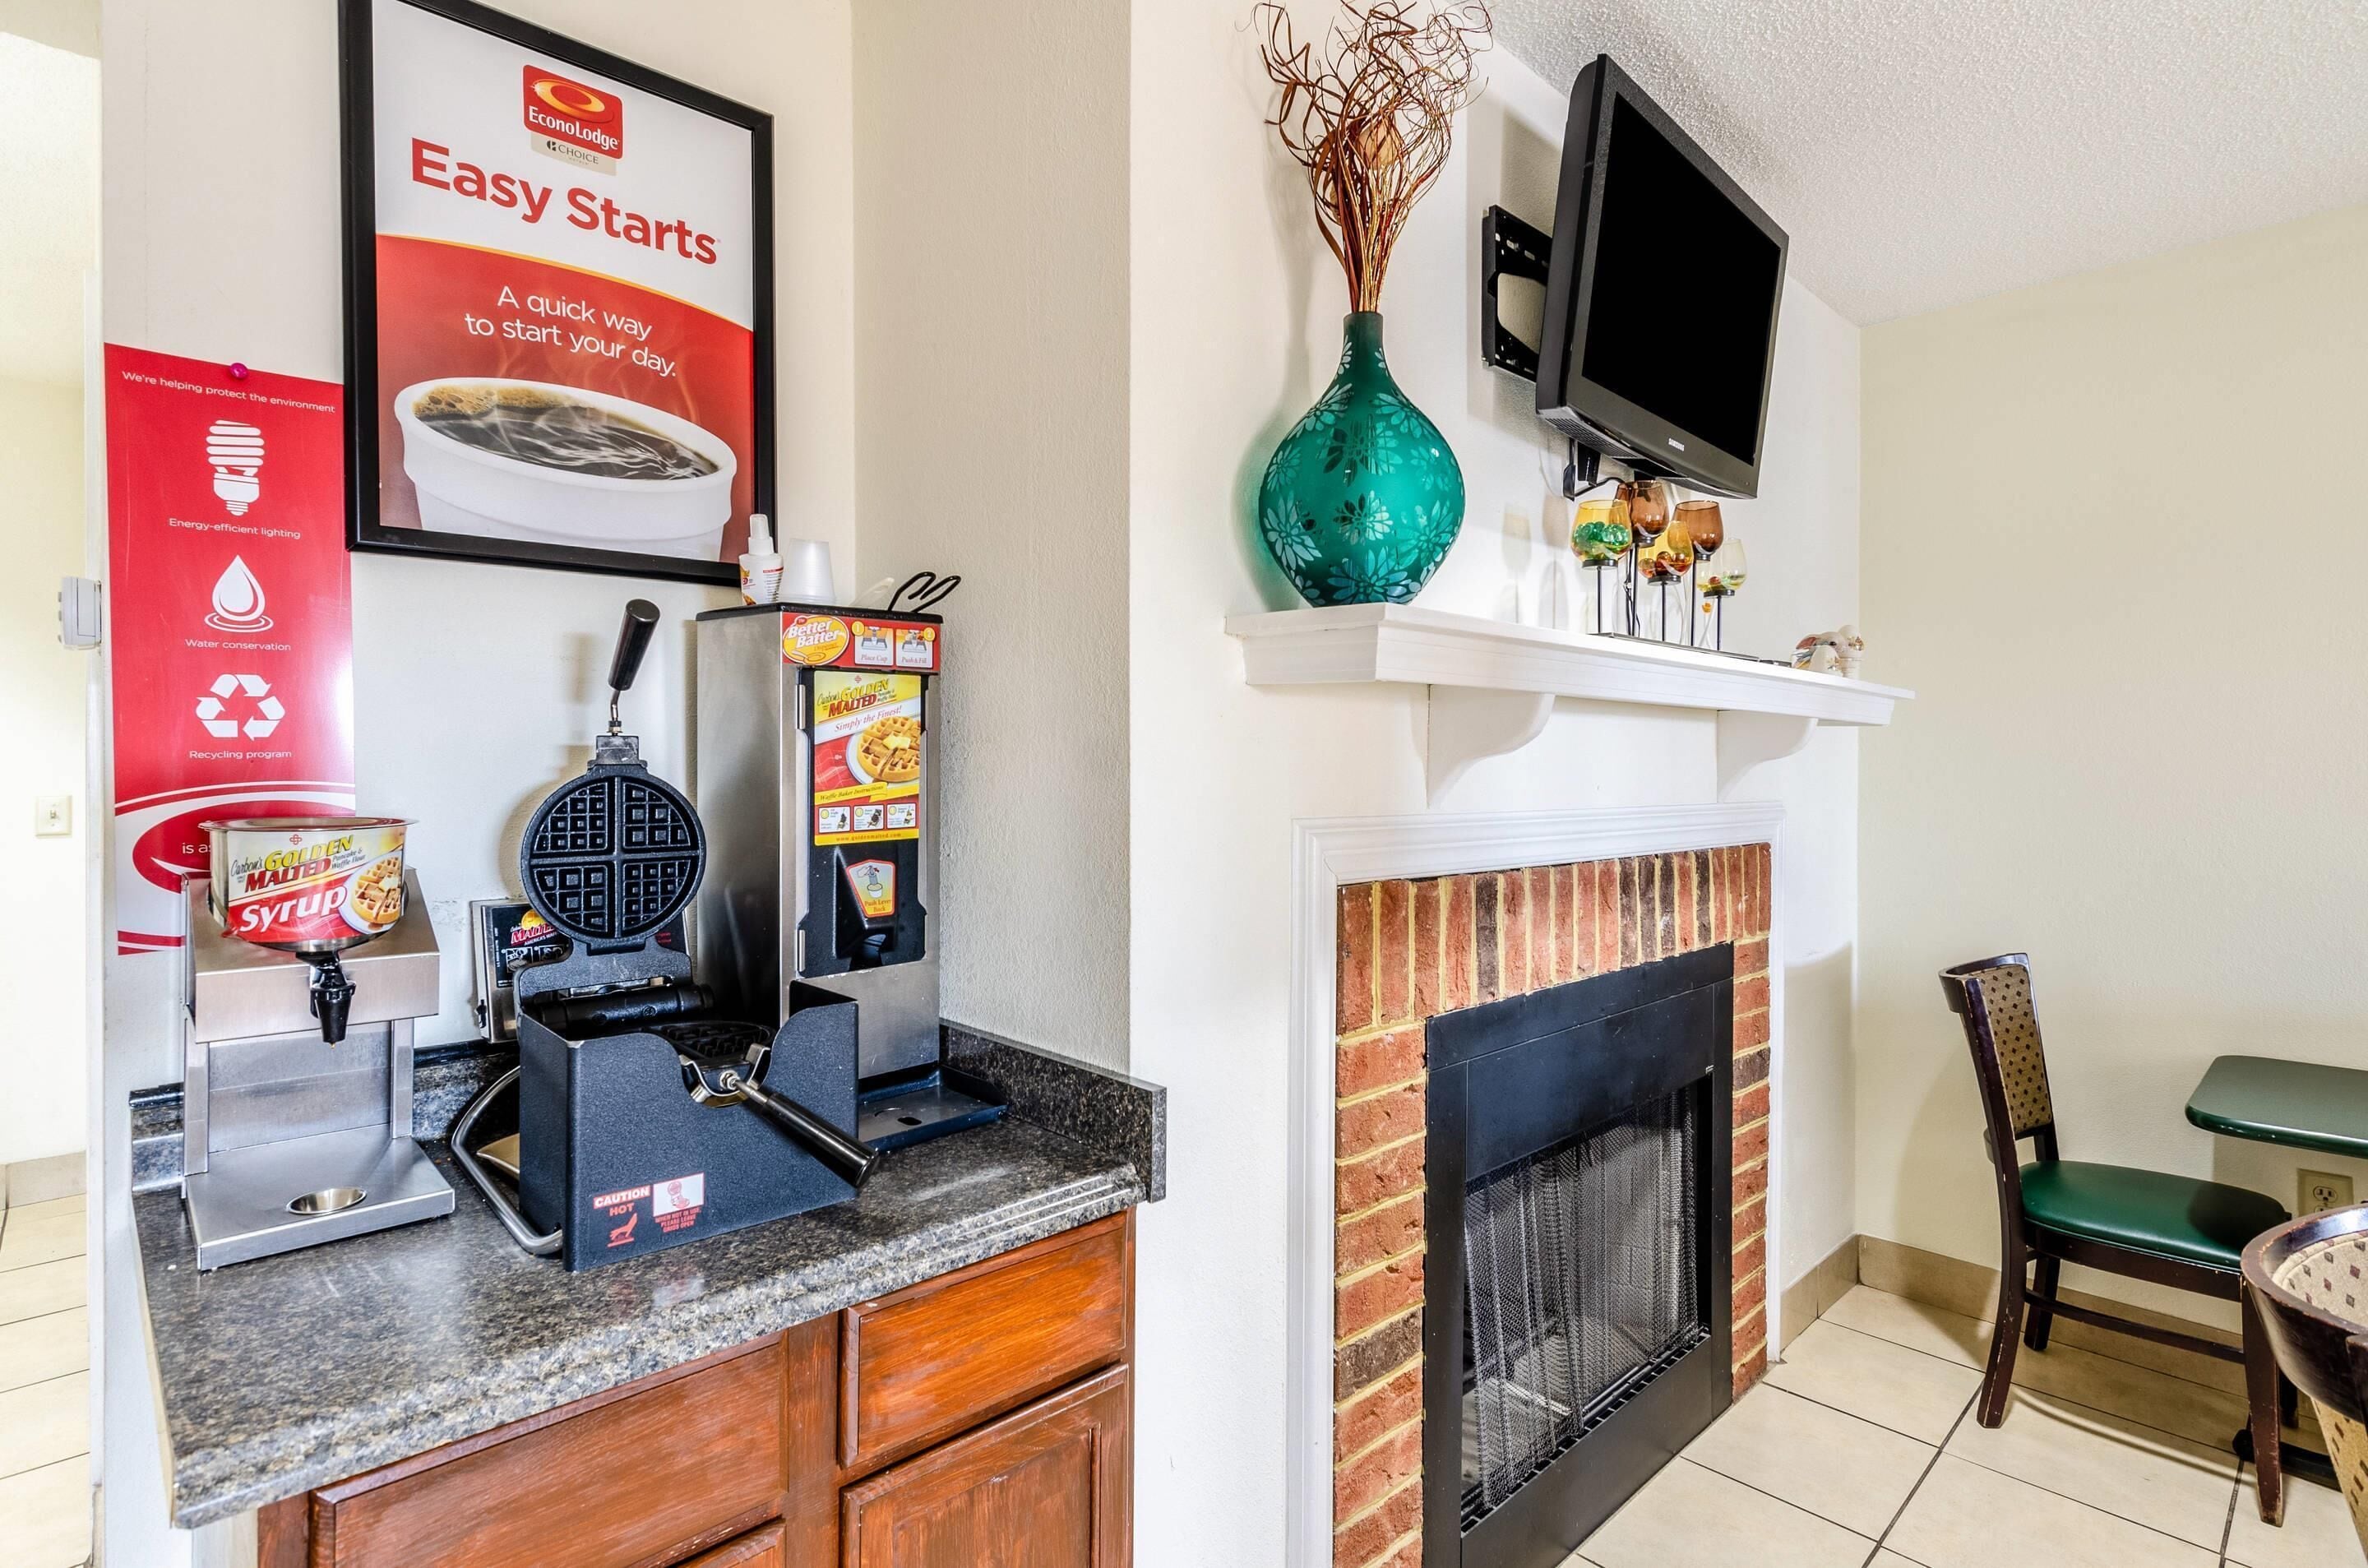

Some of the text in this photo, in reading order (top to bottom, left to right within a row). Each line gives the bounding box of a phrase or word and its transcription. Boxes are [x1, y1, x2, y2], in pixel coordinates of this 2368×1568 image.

[529, 105, 618, 150] EconoLodge
[557, 143, 599, 164] CHOICE
[412, 137, 718, 266] Easy Starts
[497, 285, 653, 342] A quick way
[465, 313, 678, 377] to start your day.
[122, 371, 336, 414] We're helping protect the environment
[169, 518, 302, 539] Energy-efficient lighting
[788, 619, 834, 639] Better
[796, 630, 840, 648] Batter
[184, 638, 292, 652] Water conservation
[876, 655, 888, 664] Cup
[841, 678, 890, 702] GOLDEN
[829, 693, 877, 717] MALTED
[835, 705, 903, 732] Simply the Finest!
[189, 750, 293, 761] Recycling program
[182, 843, 195, 854] is
[231, 835, 354, 877] Carbon's GOLDEN
[245, 858, 332, 893] MALTED
[239, 885, 348, 933] Syrup
[594, 1186, 650, 1208] CAUTION
[609, 1203, 635, 1217] HOT
